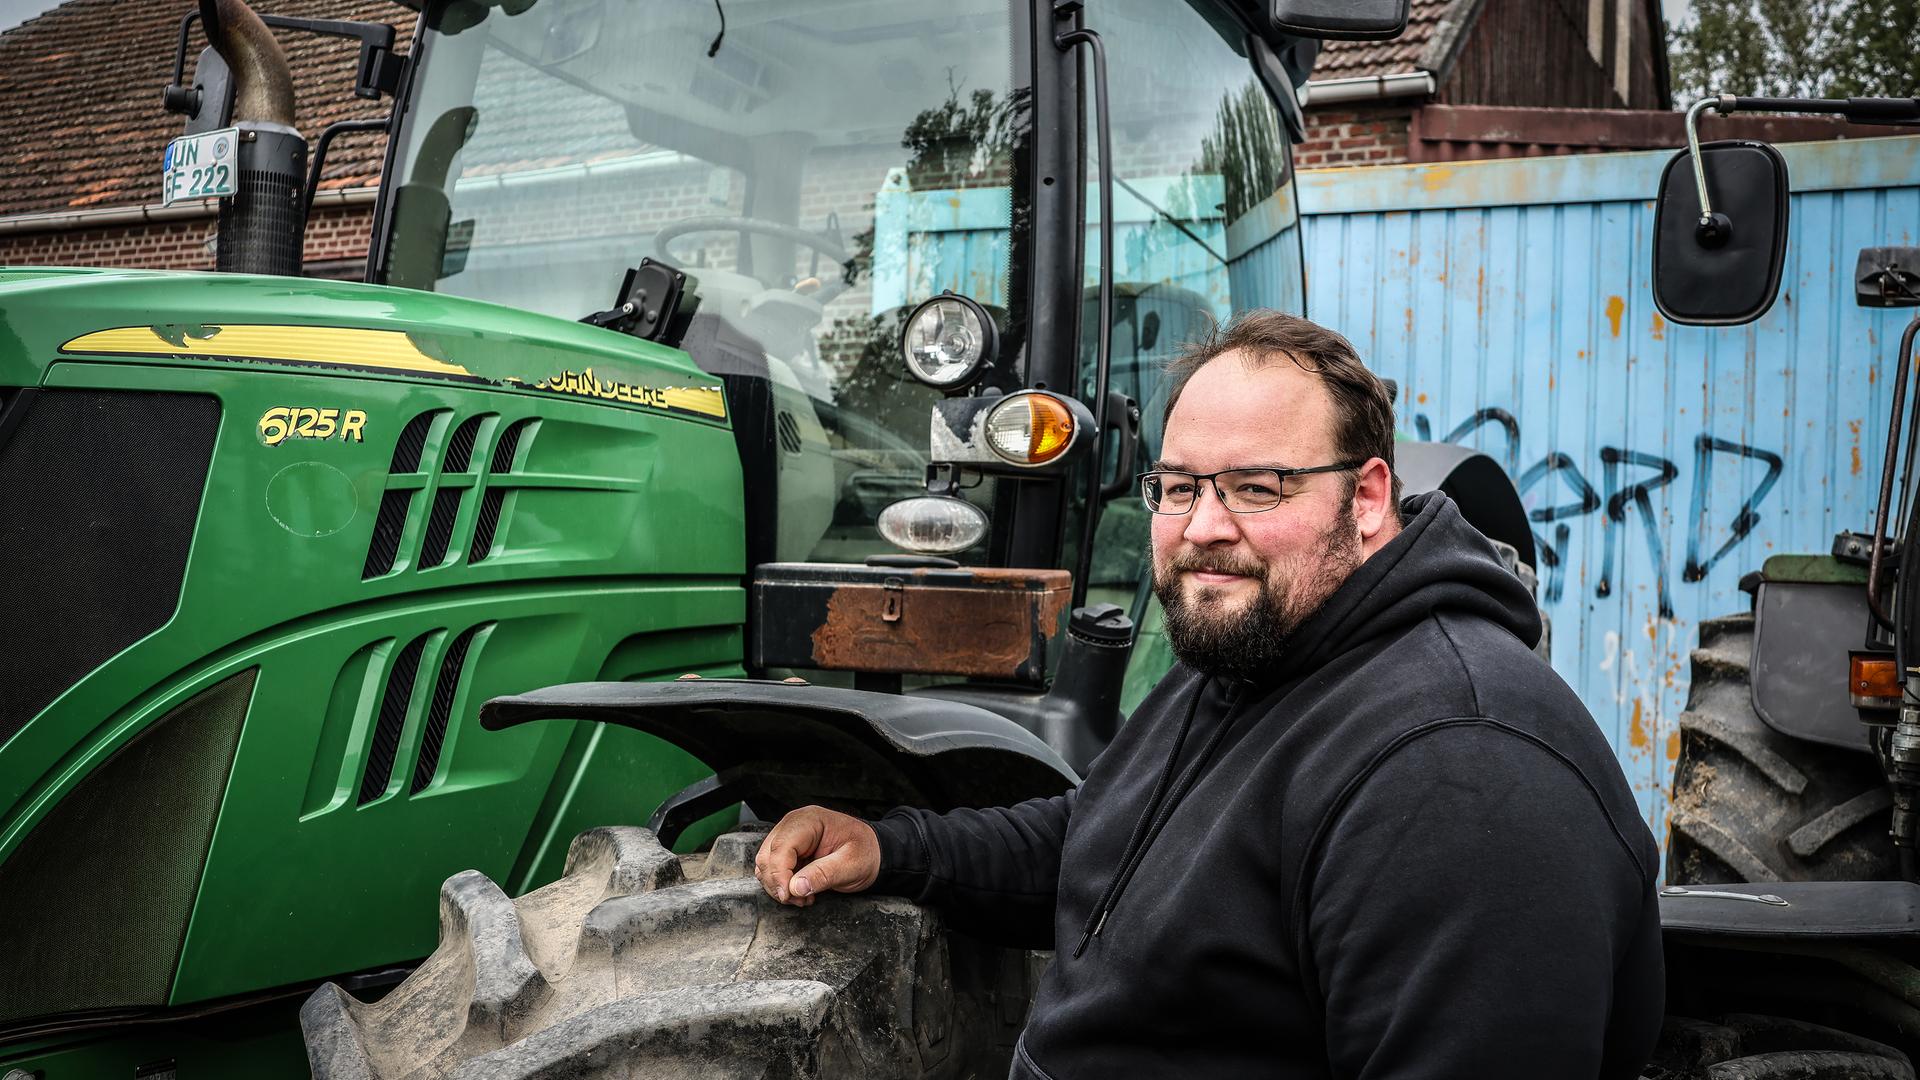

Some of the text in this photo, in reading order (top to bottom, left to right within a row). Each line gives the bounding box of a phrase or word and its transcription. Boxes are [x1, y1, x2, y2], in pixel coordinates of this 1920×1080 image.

[173, 139, 199, 168] UN
[188, 165, 230, 195] 222
[258, 406, 367, 446] 6125 R
